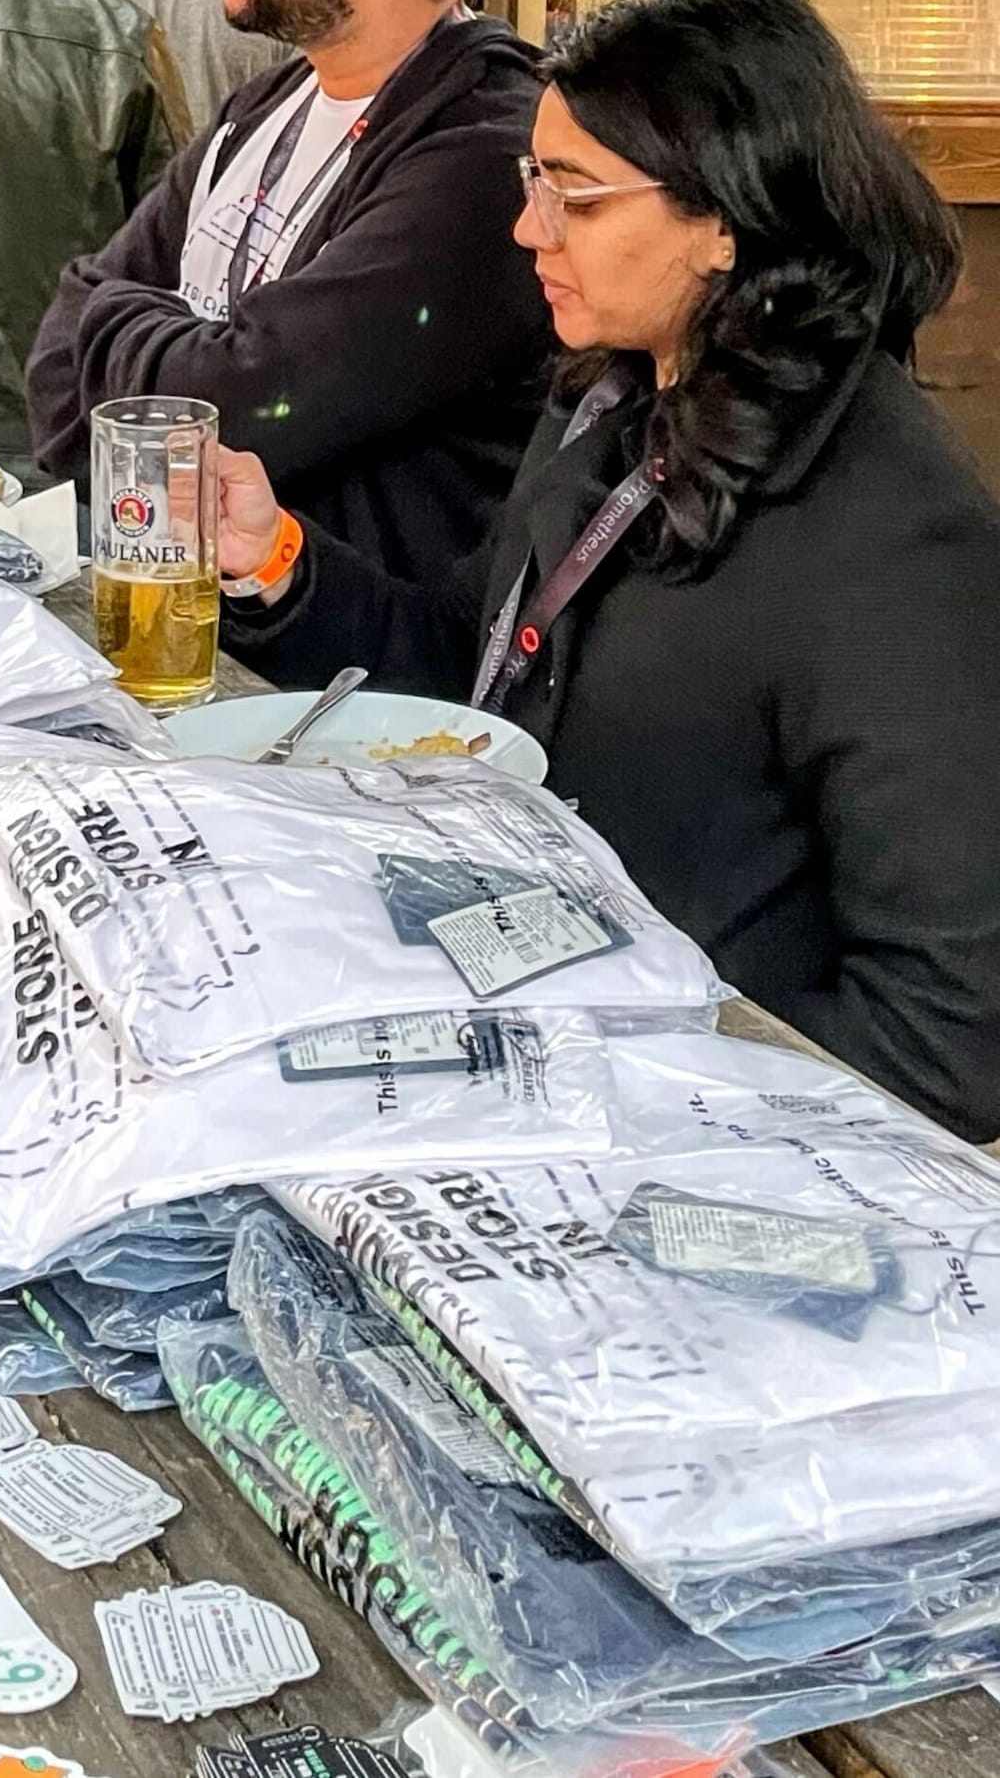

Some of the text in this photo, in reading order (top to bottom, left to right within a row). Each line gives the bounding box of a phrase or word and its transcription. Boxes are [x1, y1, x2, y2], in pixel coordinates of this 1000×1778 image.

[576, 478, 651, 564] Prometheus
[7, 809, 111, 929] DESIGN
[70, 799, 167, 892] STORE
[12, 908, 61, 1075] STORE
[376, 1071, 399, 1114] This
[946, 1255, 987, 1317] This
